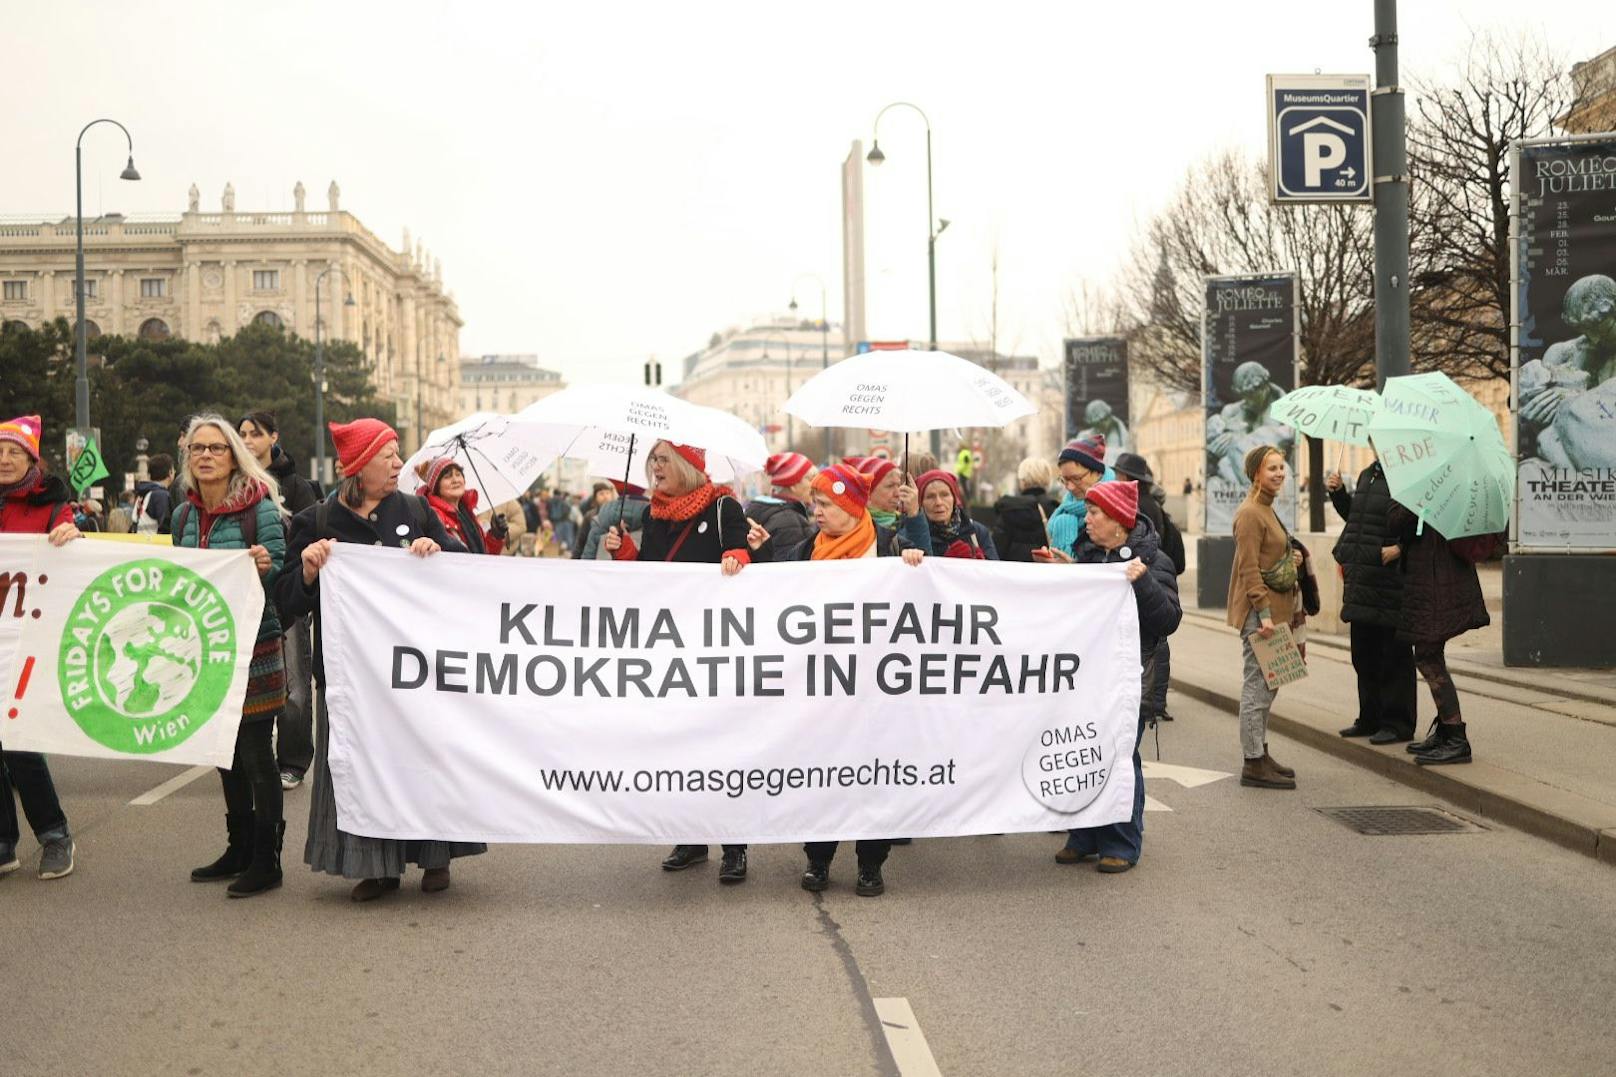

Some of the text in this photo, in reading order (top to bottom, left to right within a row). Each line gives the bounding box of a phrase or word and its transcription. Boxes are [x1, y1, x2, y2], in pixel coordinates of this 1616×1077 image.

[1283, 94, 1360, 104] MuseumsQuartier
[1303, 132, 1346, 187] P
[1334, 178, 1346, 187] 40
[849, 393, 885, 404] GEGEN
[855, 383, 888, 393] OMAS
[626, 416, 670, 430] RECHTS
[628, 408, 668, 421] GEGEN
[842, 404, 881, 416] RECHTS
[1383, 397, 1441, 425] WASSER
[1382, 436, 1436, 468] ERDE
[1416, 463, 1454, 508] reduce
[1527, 481, 1615, 493] THEATE
[1534, 493, 1552, 501] AN
[1557, 493, 1584, 501] DER
[1463, 479, 1479, 532] recycle
[65, 566, 232, 712] FRIDAYS FOR FUTURE
[499, 601, 1002, 649] KLIMA IN GEFAHR
[391, 645, 1080, 698] DEMOKRATIE IN GEFAHR
[133, 713, 190, 746] Wien
[1040, 722, 1097, 747] OMAS
[1039, 745, 1102, 773] GEGEN
[540, 758, 956, 798] www.omasgegenrechts.at
[1040, 768, 1106, 798] RECHTS
